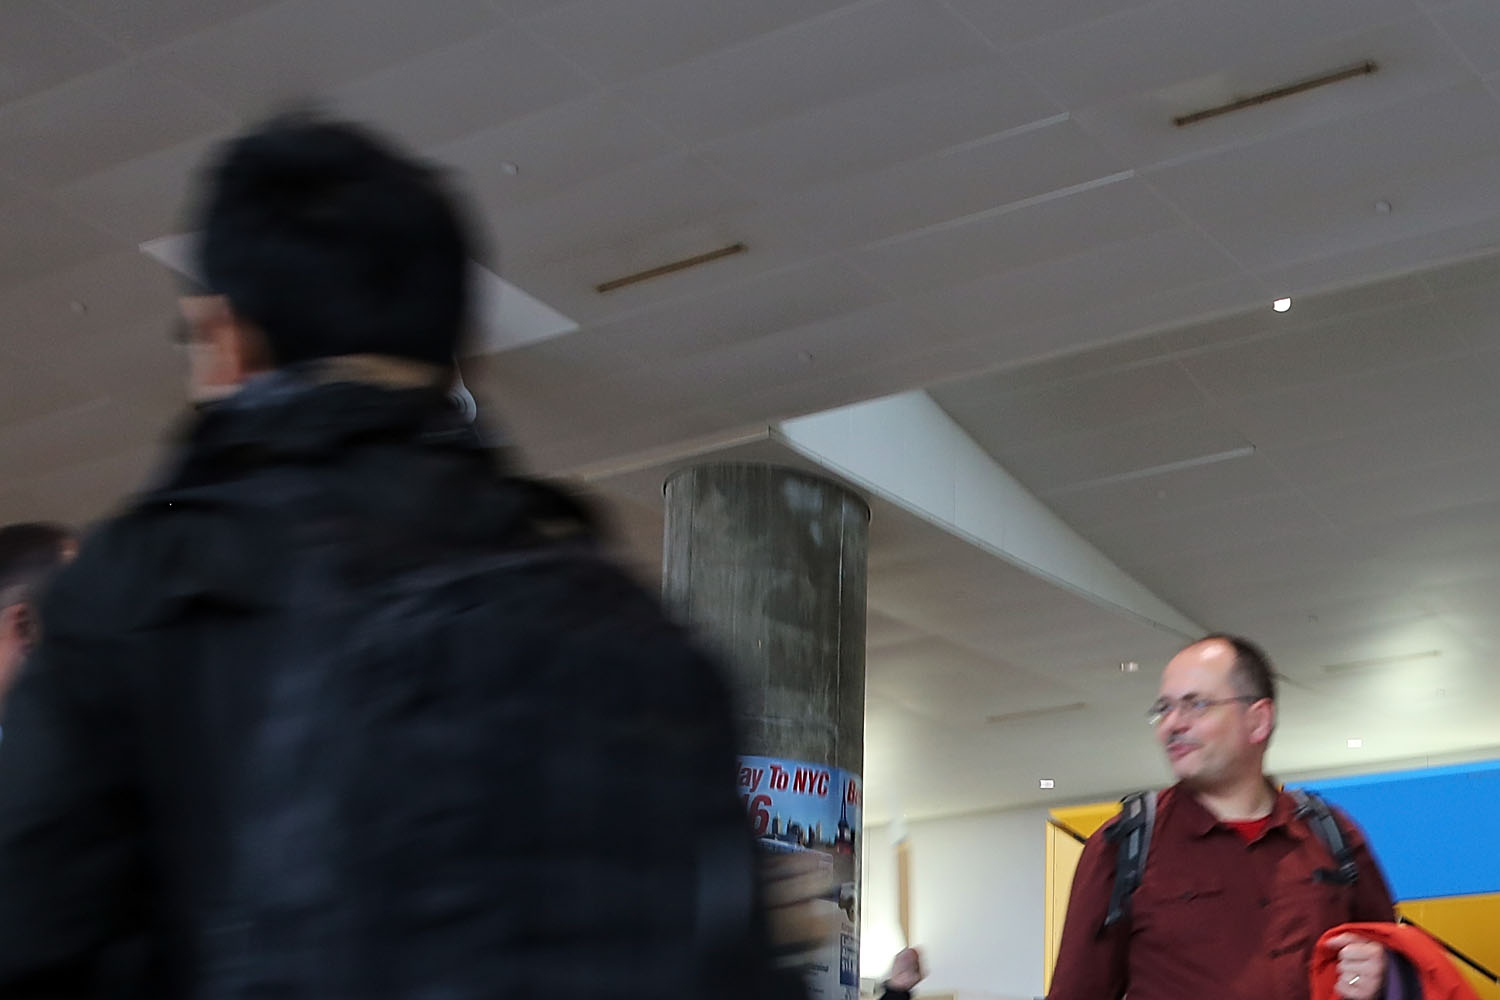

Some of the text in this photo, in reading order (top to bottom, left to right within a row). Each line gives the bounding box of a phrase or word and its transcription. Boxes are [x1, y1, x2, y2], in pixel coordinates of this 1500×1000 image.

[737, 761, 830, 798] ay To NYC
